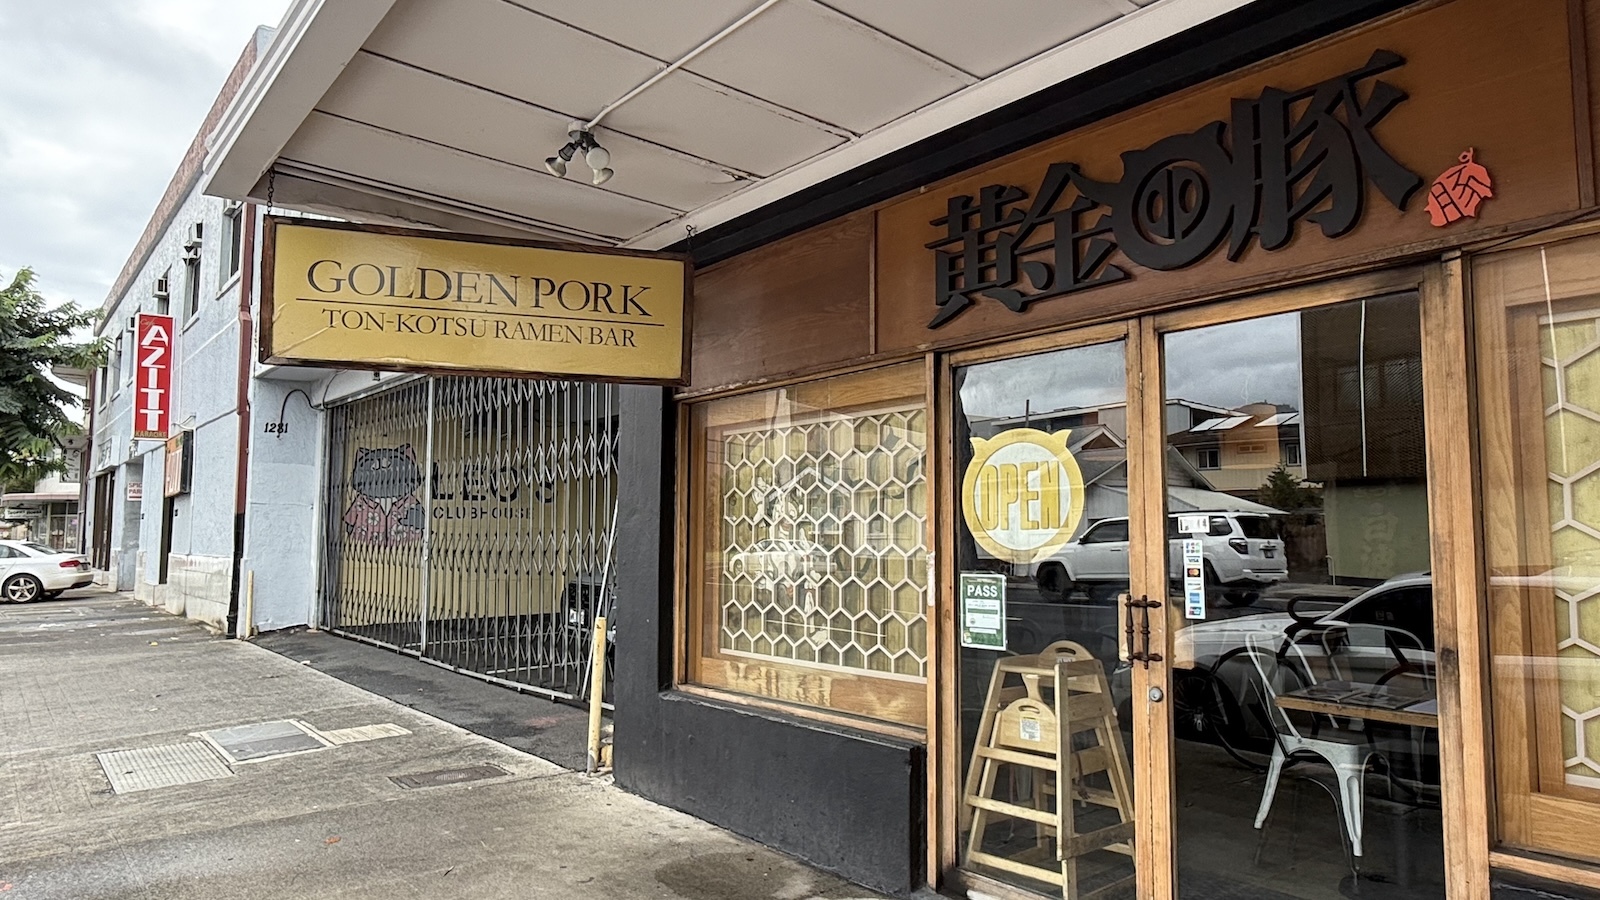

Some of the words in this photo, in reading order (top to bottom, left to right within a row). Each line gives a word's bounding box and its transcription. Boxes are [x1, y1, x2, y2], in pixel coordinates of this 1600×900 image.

[307, 258, 521, 308] GOLDEN
[533, 276, 653, 318] PORK
[322, 308, 487, 338] TON-KOTSU
[140, 324, 169, 431] AZITT
[264, 422, 288, 433] 1281
[981, 460, 1060, 530] OPEN
[967, 584, 998, 598] PASS
